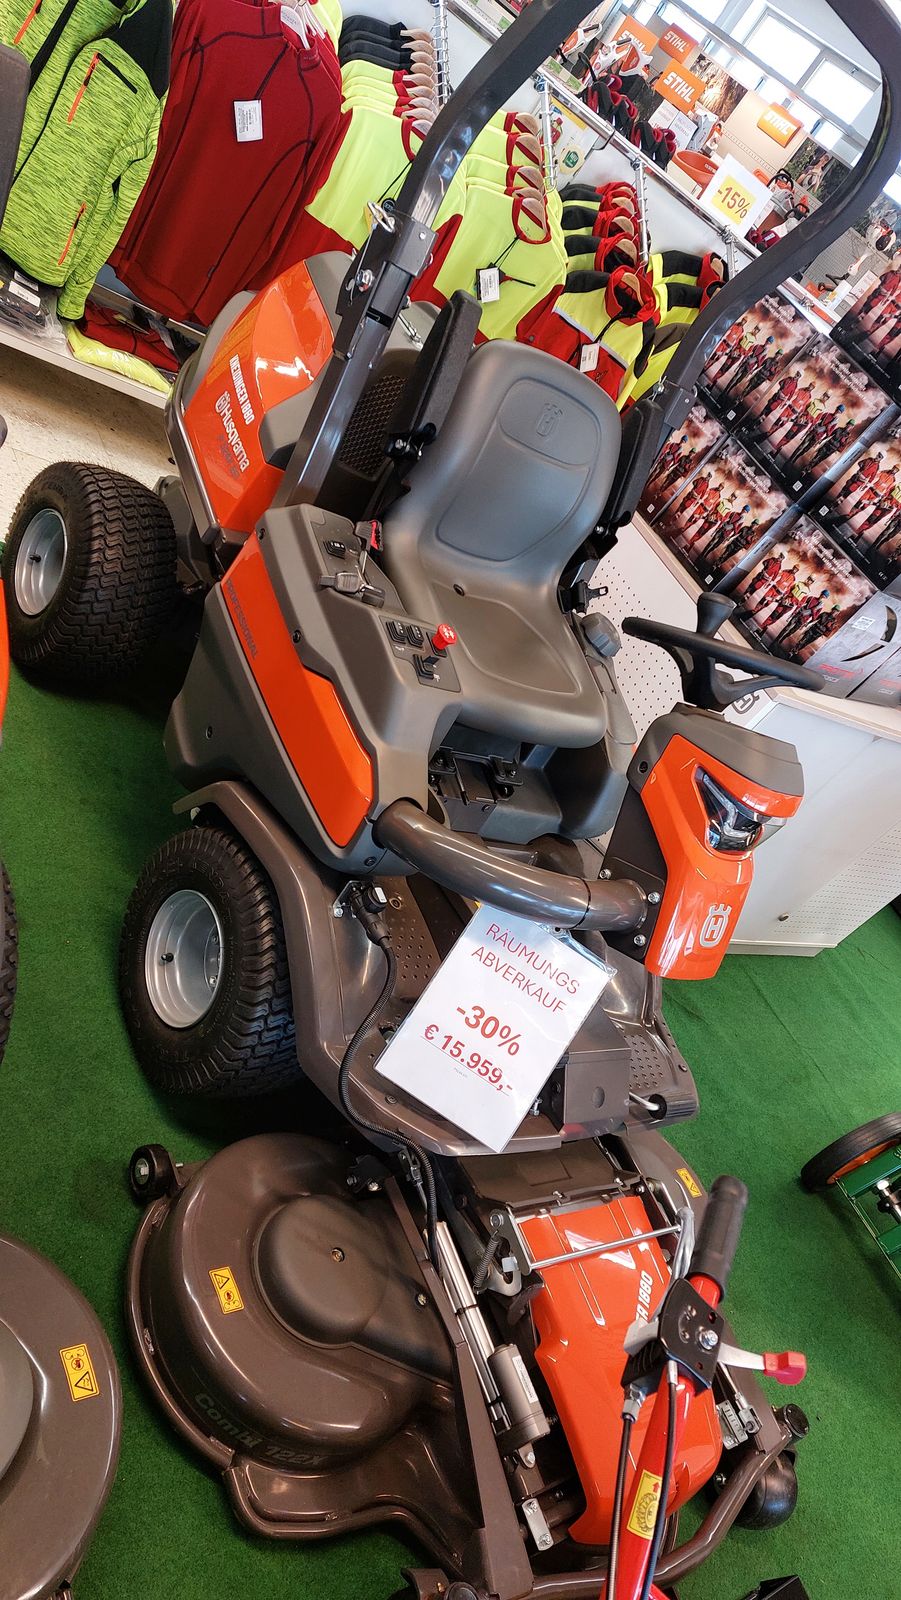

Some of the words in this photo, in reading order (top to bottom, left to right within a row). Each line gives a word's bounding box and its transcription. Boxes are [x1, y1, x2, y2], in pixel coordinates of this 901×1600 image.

[663, 30, 686, 53] STIHL
[663, 71, 696, 104] STIHL
[717, 186, 751, 219] -15%
[241, 400, 255, 425] 1880
[220, 408, 250, 472] Husqvarna
[226, 579, 257, 659] PROFESSIONAL
[471, 946, 567, 1014] ABVERKAUF
[485, 922, 580, 995] RÄUMUNGS
[455, 1004, 522, 1057] -30%
[424, 1024, 439, 1041] €
[440, 1034, 513, 1091] 15.959,-
[638, 1270, 653, 1307] 1880
[195, 1394, 262, 1447] Combi
